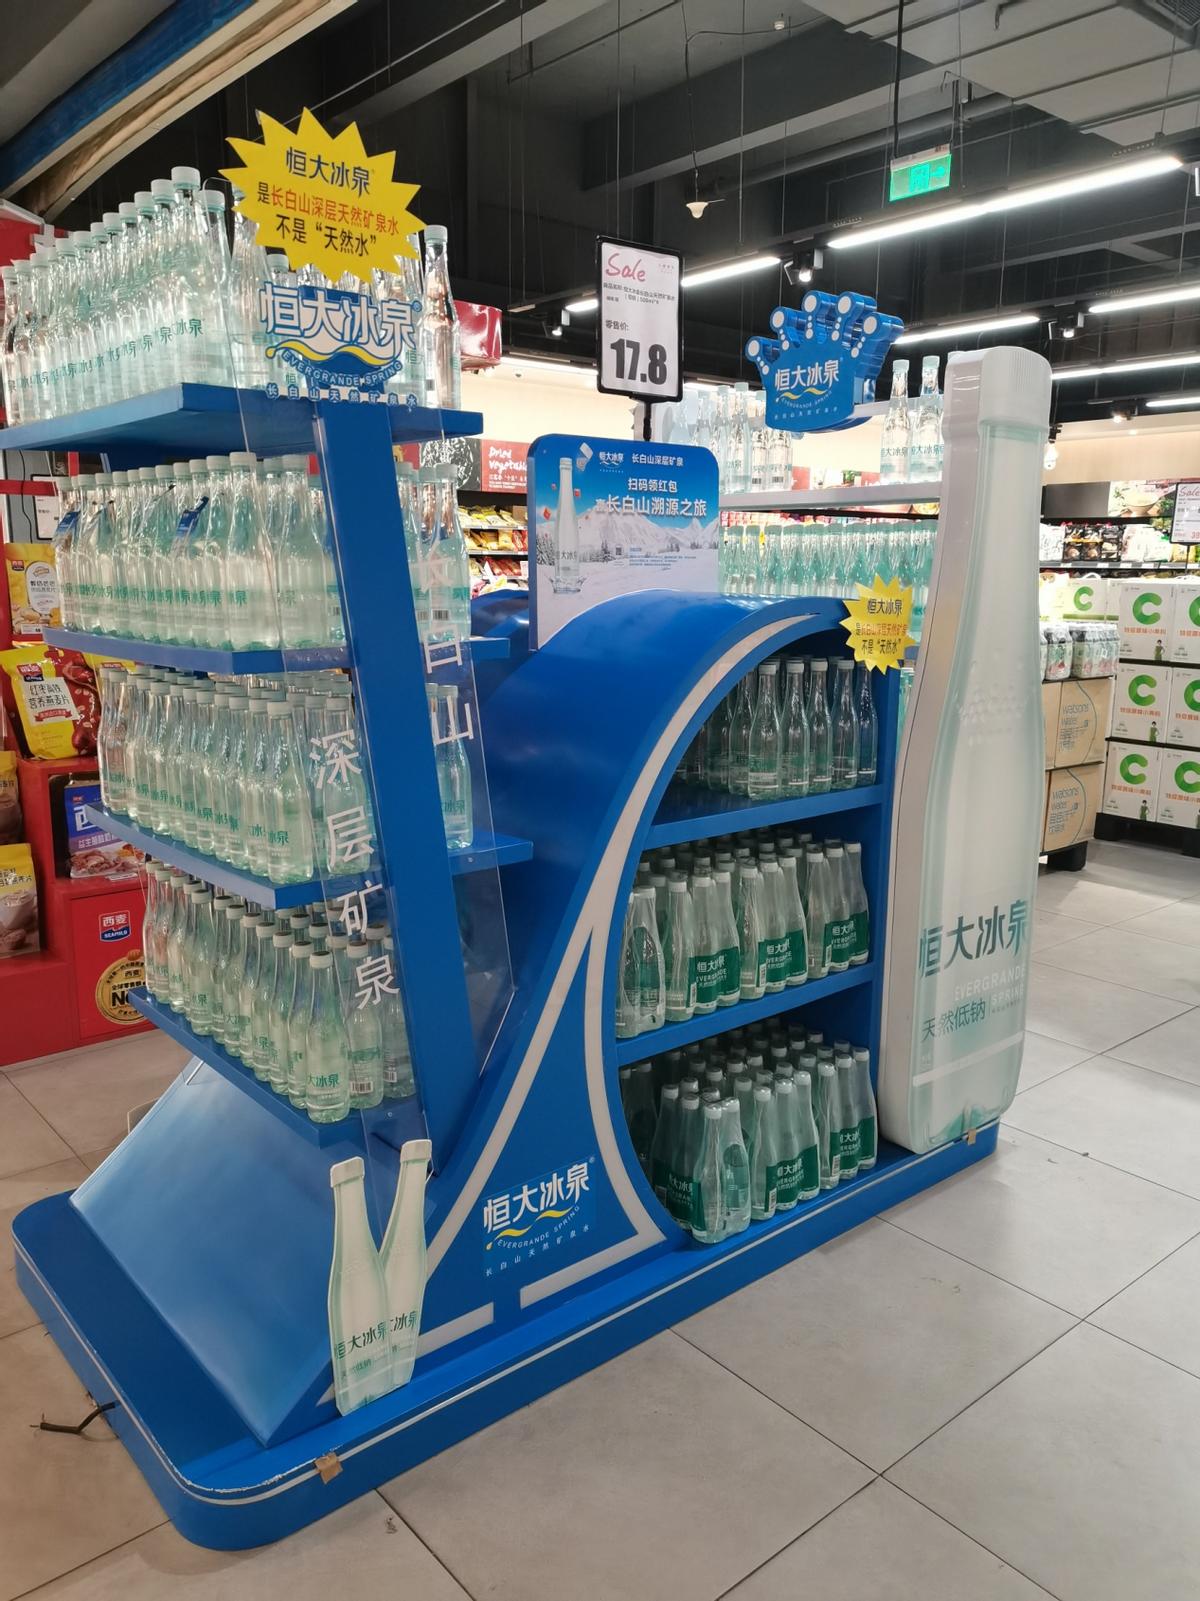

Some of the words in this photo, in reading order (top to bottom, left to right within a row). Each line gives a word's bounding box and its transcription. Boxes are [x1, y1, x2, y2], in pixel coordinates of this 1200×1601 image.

[286, 146, 371, 198] 恒大冰泉
[257, 181, 400, 236] 是长白山深层天然矿泉水
[605, 252, 646, 282] Sale
[259, 281, 417, 360] 恒大冰泉
[281, 348, 361, 386] EVERGRANDE
[364, 359, 403, 387] SPRING
[610, 337, 668, 386] 17.8
[774, 359, 840, 391] 恒大冰泉
[265, 382, 419, 407] 长白山天然矿泉水
[628, 477, 679, 493] 扫码领红包
[1132, 592, 1163, 626] C
[1128, 674, 1158, 707] C
[1119, 753, 1148, 785] C
[310, 729, 400, 1010] 深层矿泉
[102, 914, 127, 927] 西麦
[918, 898, 1028, 980] 恒大冰泉
[921, 996, 987, 1043] 天然低钠
[483, 1162, 590, 1234] 恒大冰泉
[497, 1231, 550, 1249] EVERGRANDE
[553, 1205, 580, 1233] SPRING
[485, 1223, 590, 1277] 长白山天然矿泉水
